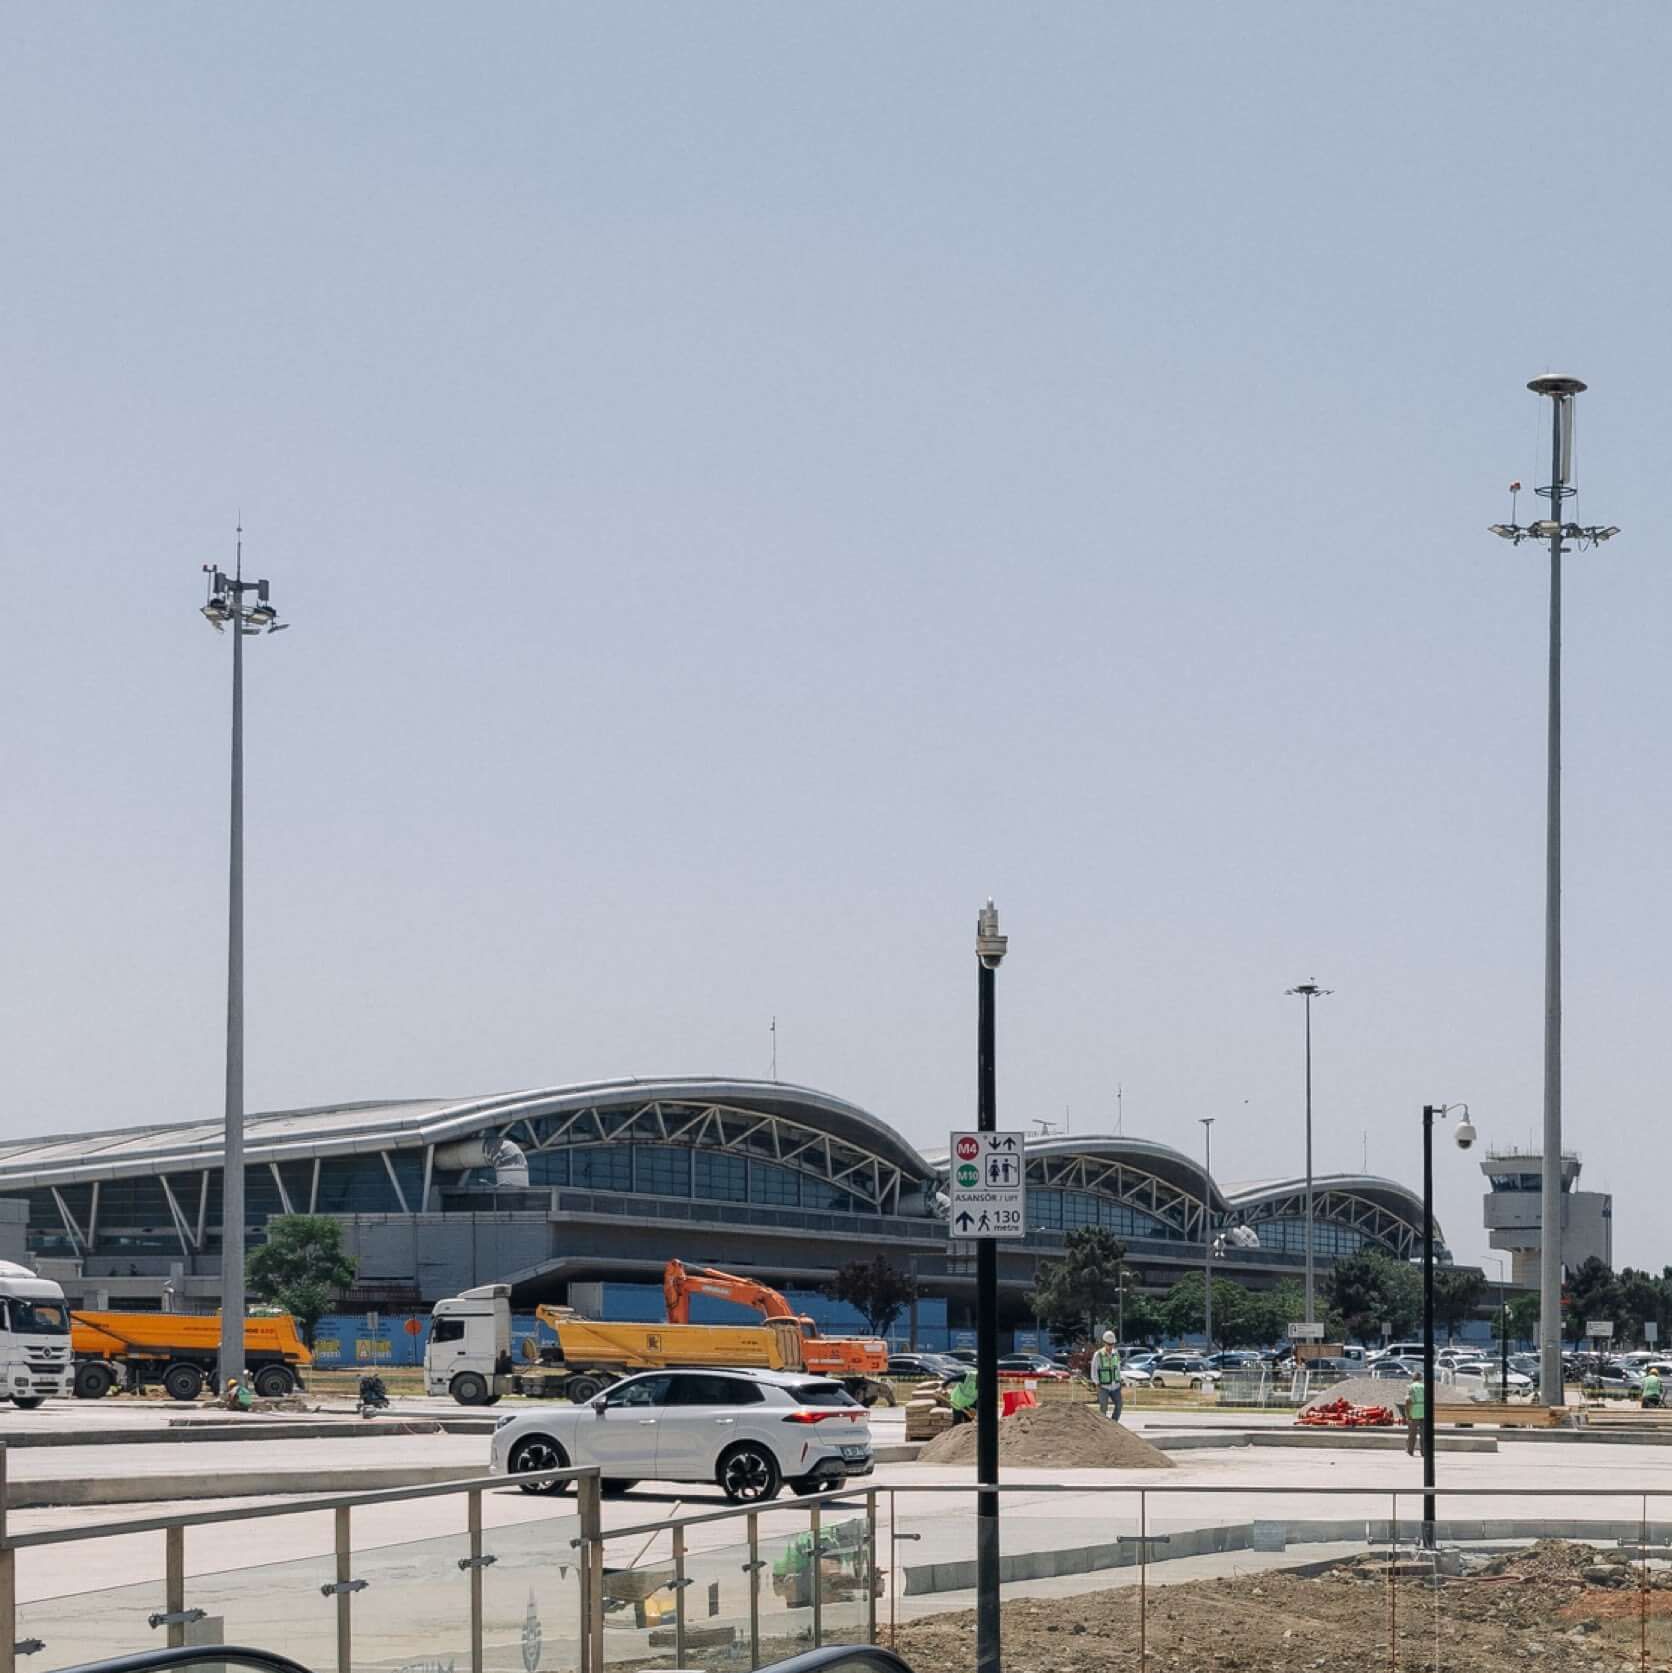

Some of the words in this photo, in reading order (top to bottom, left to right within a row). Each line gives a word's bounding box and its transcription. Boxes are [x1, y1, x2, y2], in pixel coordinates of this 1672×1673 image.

[958, 1143, 978, 1155] M4
[955, 1192, 997, 1203] ASANSÖR
[993, 1210, 1021, 1224] 130
[994, 1223, 1020, 1233] metre
